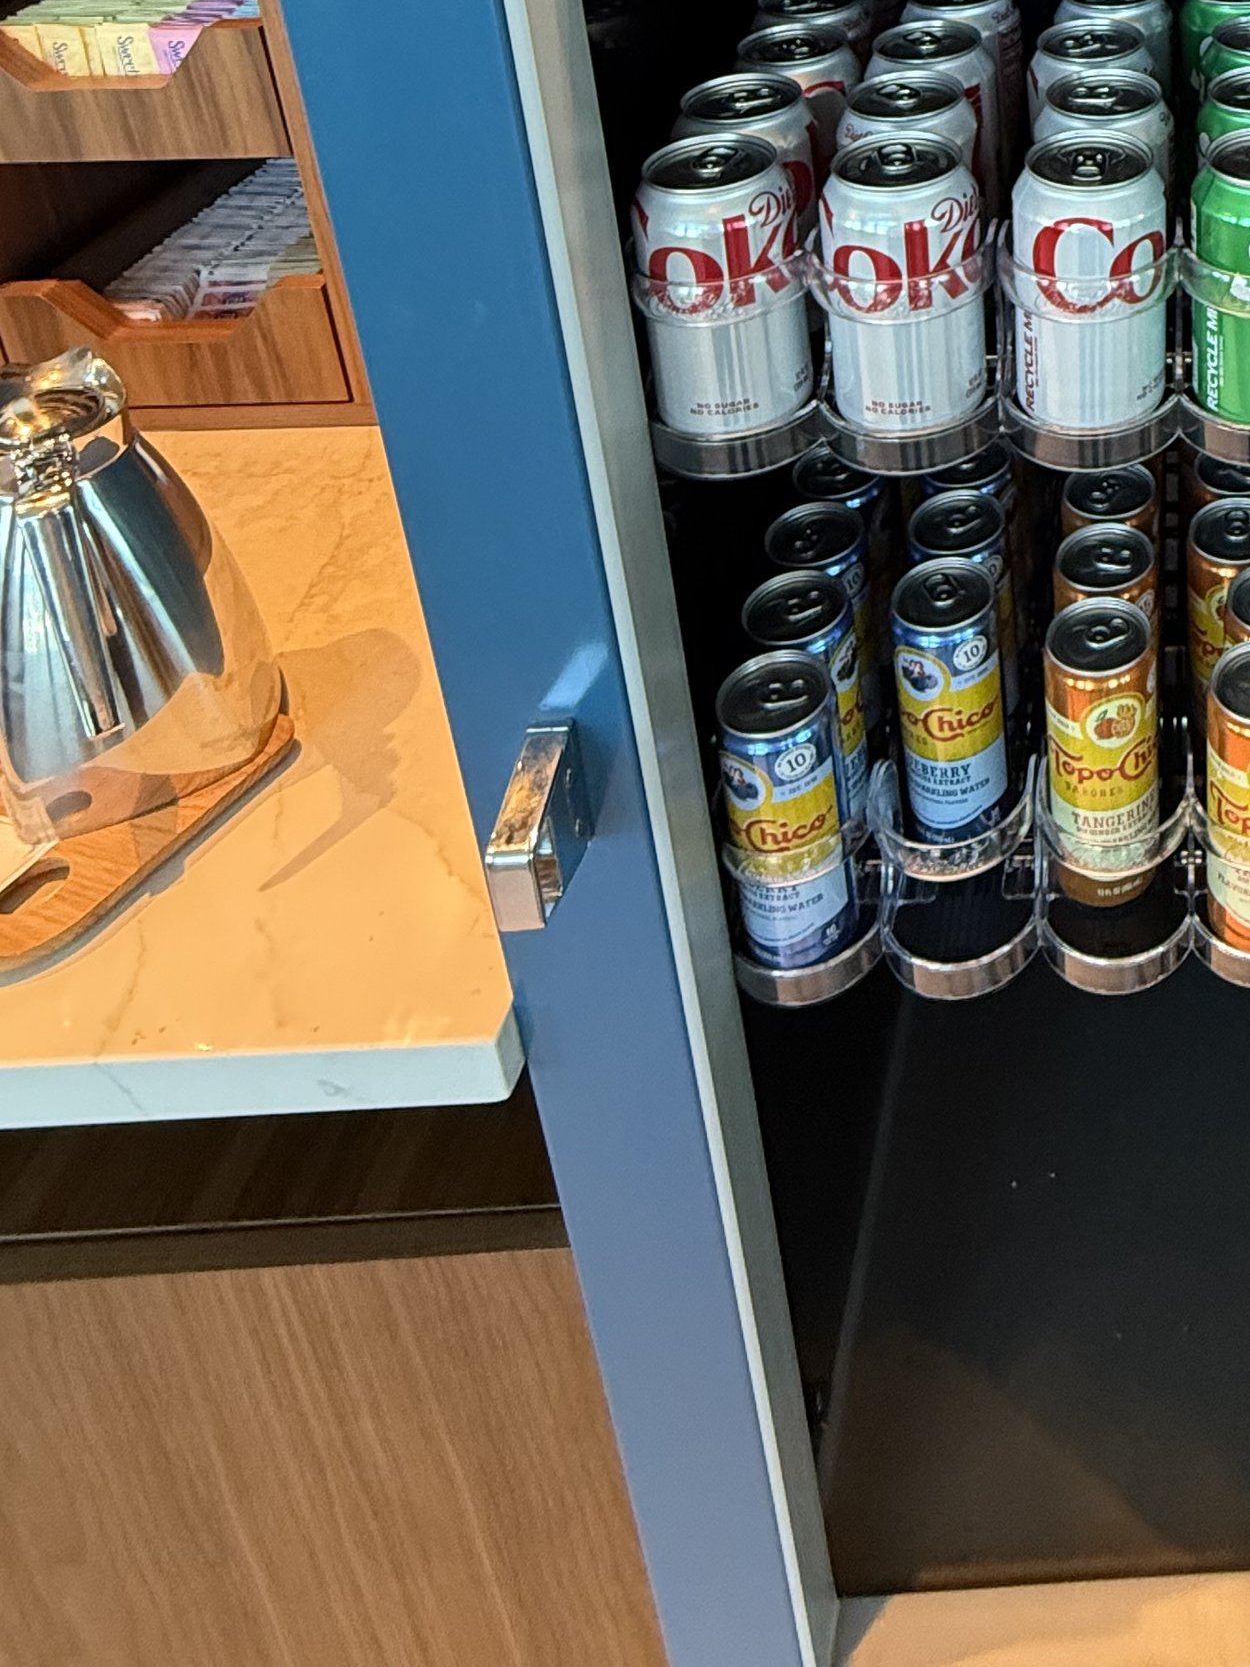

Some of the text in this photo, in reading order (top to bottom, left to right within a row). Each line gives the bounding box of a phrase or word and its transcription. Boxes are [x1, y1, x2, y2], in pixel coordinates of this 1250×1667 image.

[1024, 334, 1036, 412] RECYCLE
[1205, 337, 1219, 413] RECYCLE
[964, 644, 981, 665] 10
[921, 693, 1000, 742] Chico
[787, 752, 807, 775] 10
[1050, 734, 1122, 785] Topo
[959, 777, 990, 796] WATER
[743, 804, 834, 854] Chico
[787, 893, 824, 913] WATER
